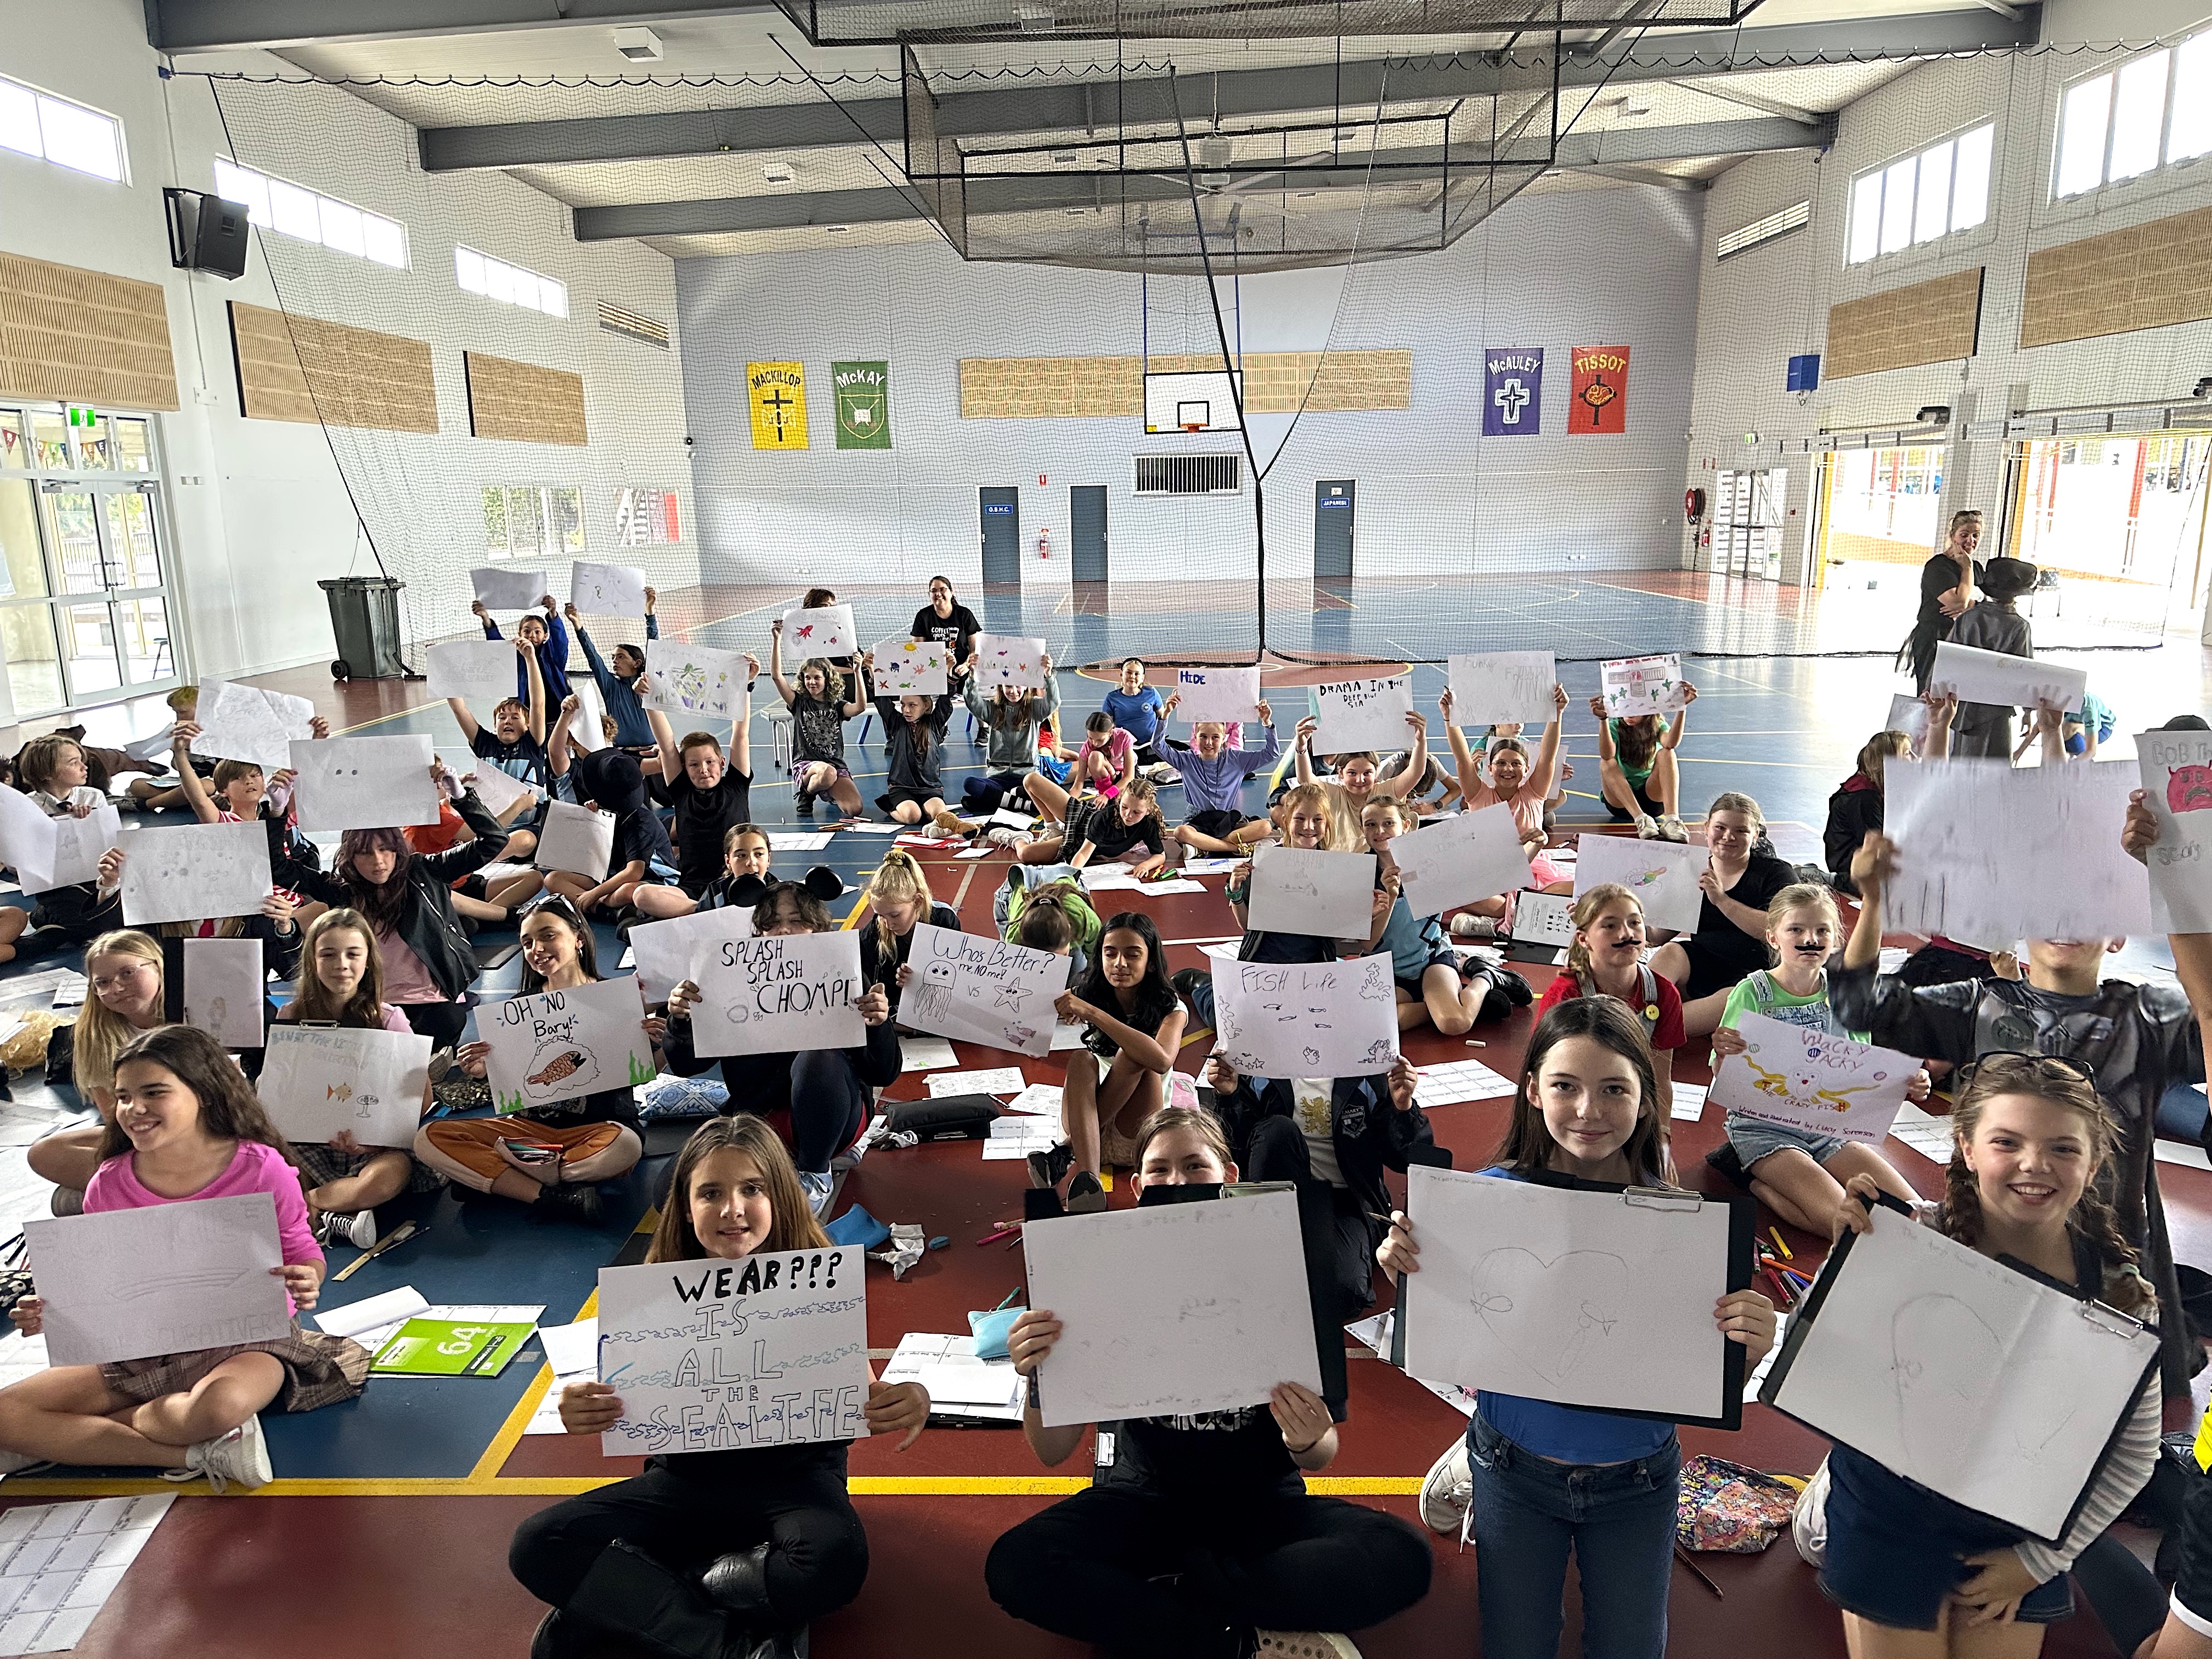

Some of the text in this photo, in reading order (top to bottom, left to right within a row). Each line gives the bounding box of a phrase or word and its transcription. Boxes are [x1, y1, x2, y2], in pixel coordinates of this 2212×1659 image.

[1488, 356, 1541, 375] McAULEY
[1575, 354, 1626, 374] TISSOT
[751, 370, 801, 390] MACKILLOP
[836, 369, 885, 388] McKAY
[1463, 654, 1497, 673] Funky
[1180, 670, 1206, 685] HIDE
[1319, 679, 1403, 696] DRAMA IN THE
[1344, 693, 1361, 702] DEEP
[720, 939, 784, 967] SPLASH
[933, 929, 984, 963] Who's
[747, 960, 804, 985] SPLASH
[1241, 965, 1289, 994] FISH
[756, 979, 850, 1014] CHOMP!
[504, 991, 566, 1025] OH NO
[533, 1017, 573, 1039] Bary!
[1784, 1099, 1810, 1110] CRAZY
[673, 1251, 843, 1304] WEAR???
[696, 1298, 748, 1342] IS
[437, 1327, 488, 1355] 64
[674, 1339, 783, 1388] ALL
[701, 1385, 759, 1403] THE
